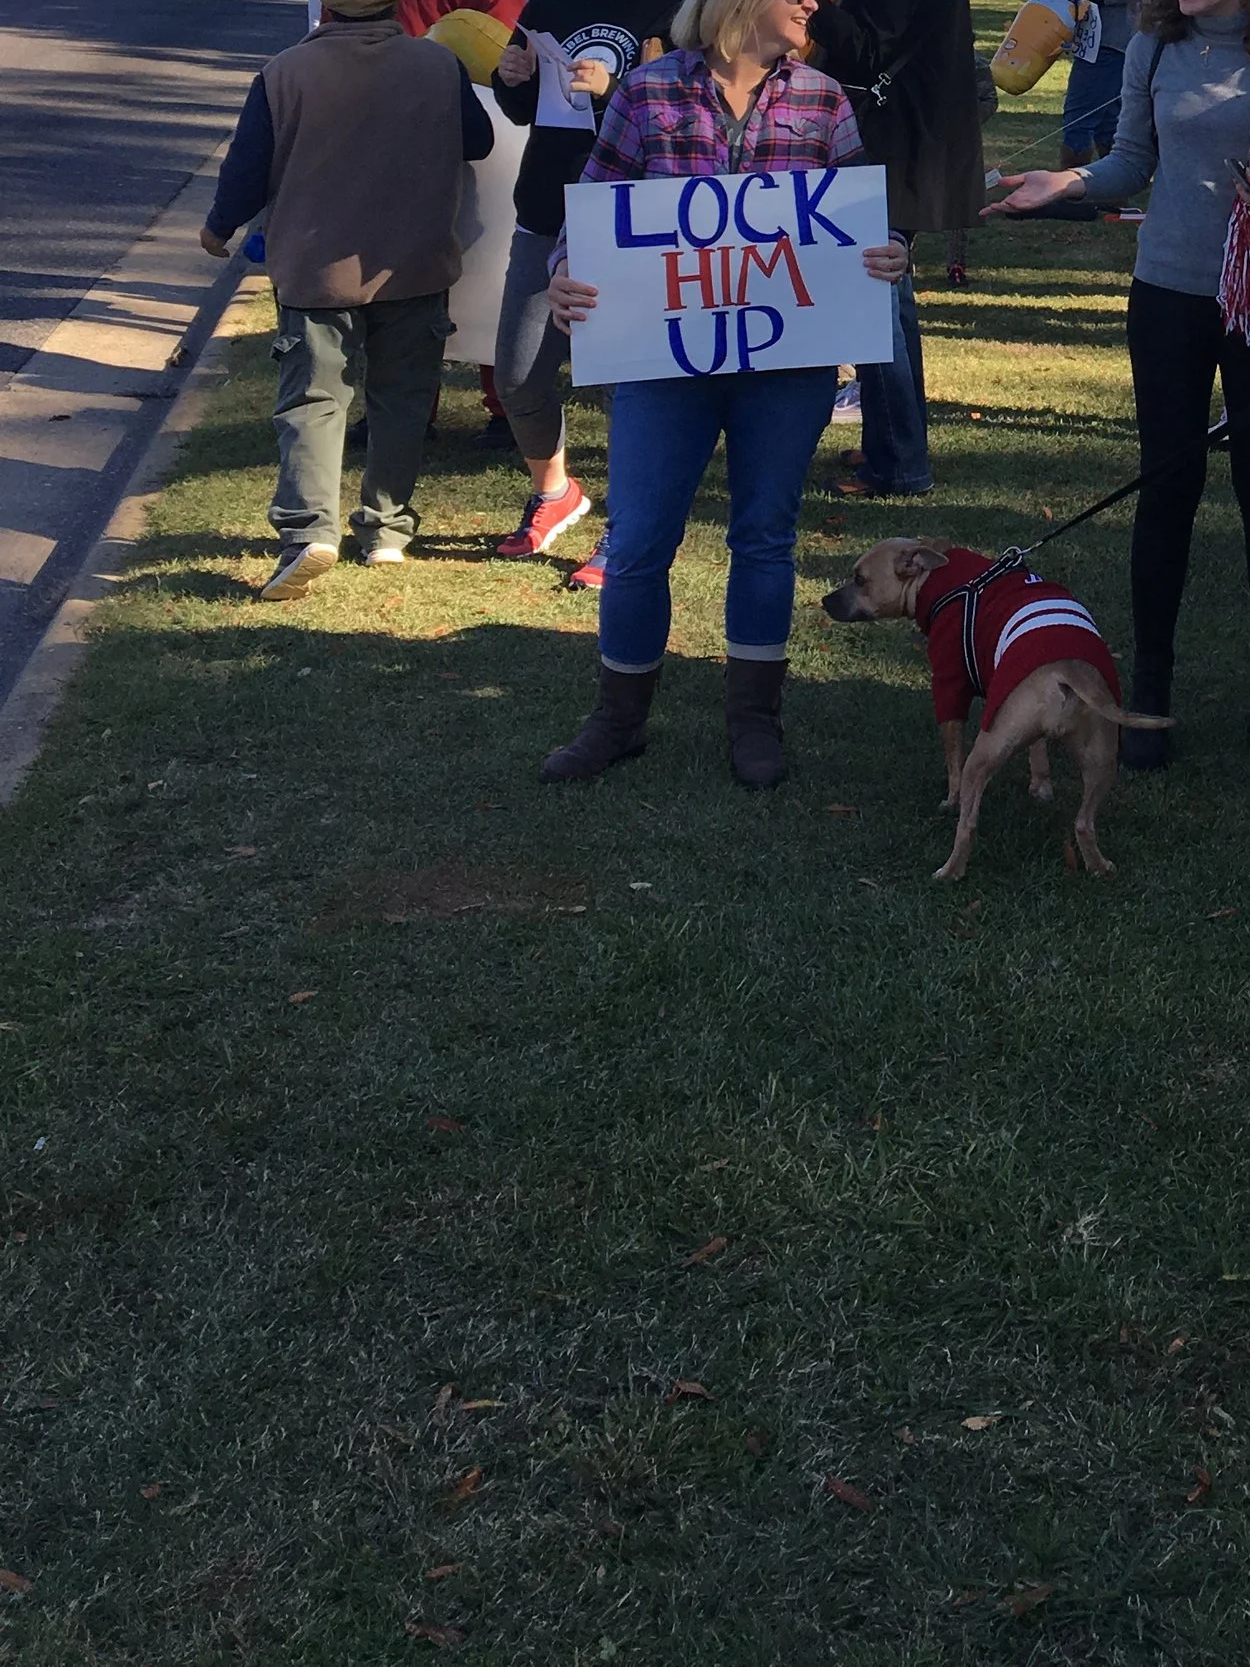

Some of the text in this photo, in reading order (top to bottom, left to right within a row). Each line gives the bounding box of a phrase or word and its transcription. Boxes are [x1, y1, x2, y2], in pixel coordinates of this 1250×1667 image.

[591, 28, 636, 61] BREWING
[610, 167, 858, 249] LOCK
[661, 235, 815, 312] HIM
[663, 305, 785, 376] UP
